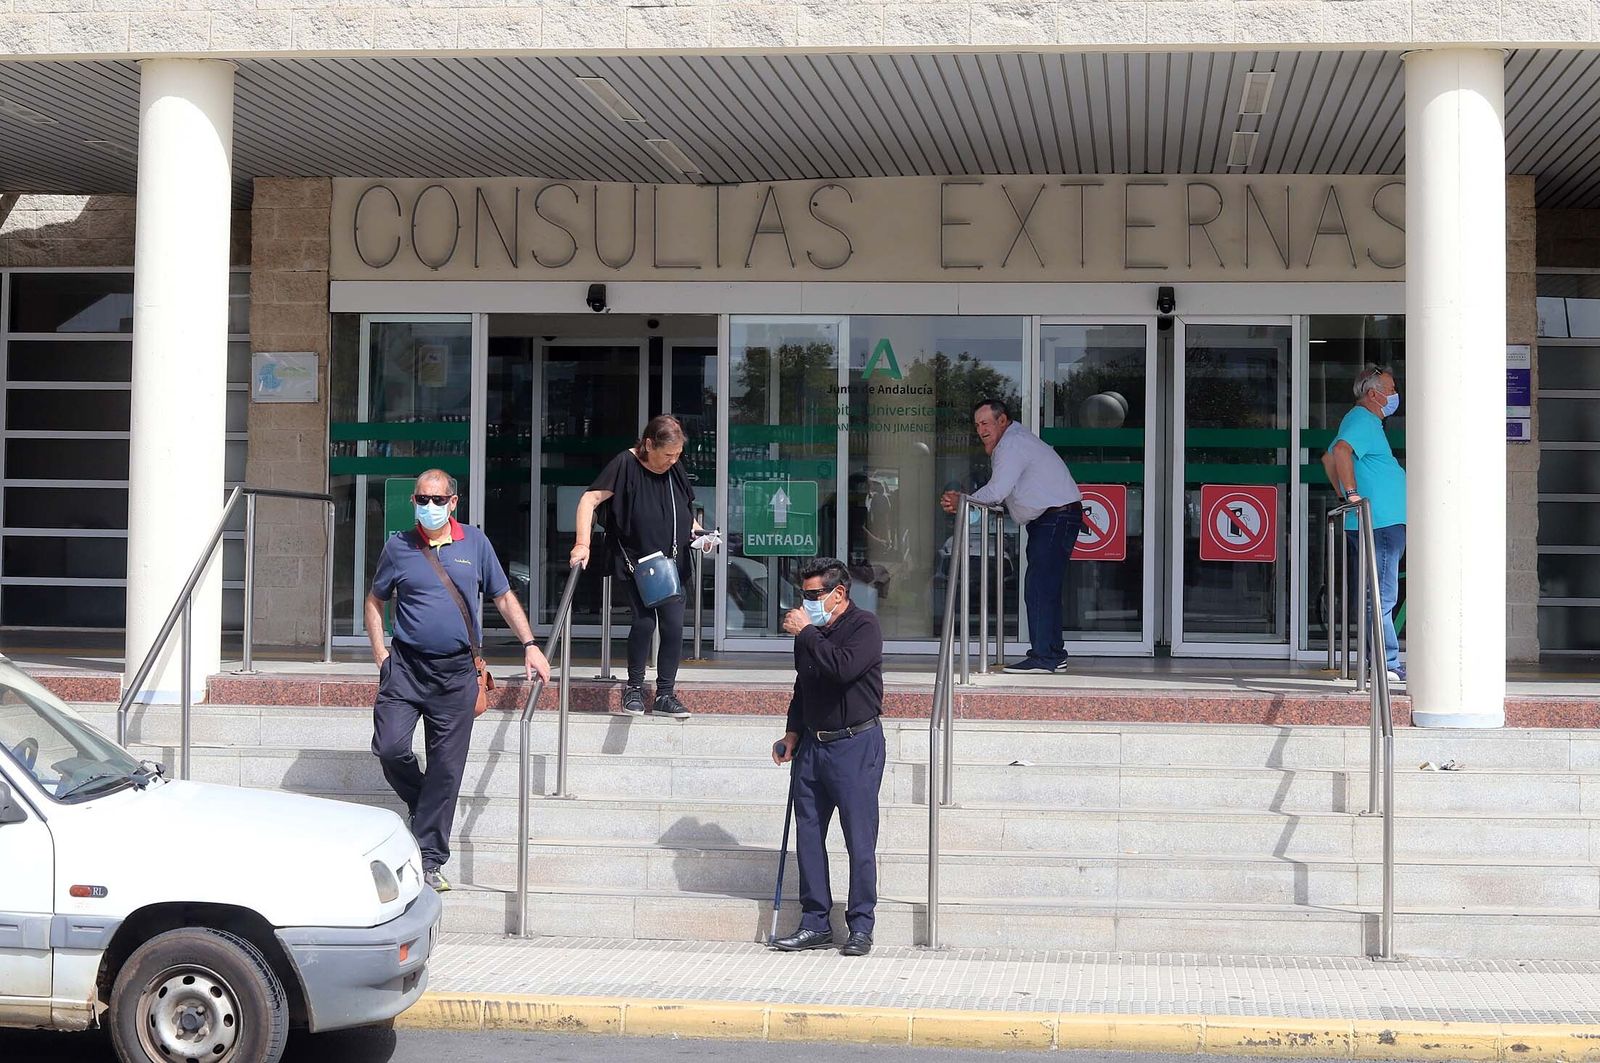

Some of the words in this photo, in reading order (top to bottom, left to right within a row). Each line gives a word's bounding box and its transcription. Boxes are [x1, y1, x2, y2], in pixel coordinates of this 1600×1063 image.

[354, 183, 853, 270] CONSULTAS
[940, 181, 1406, 270] EXTERNAS
[877, 384, 933, 395] Andalucía
[747, 534, 814, 546] ENTRADA
[92, 887, 104, 896] RL
